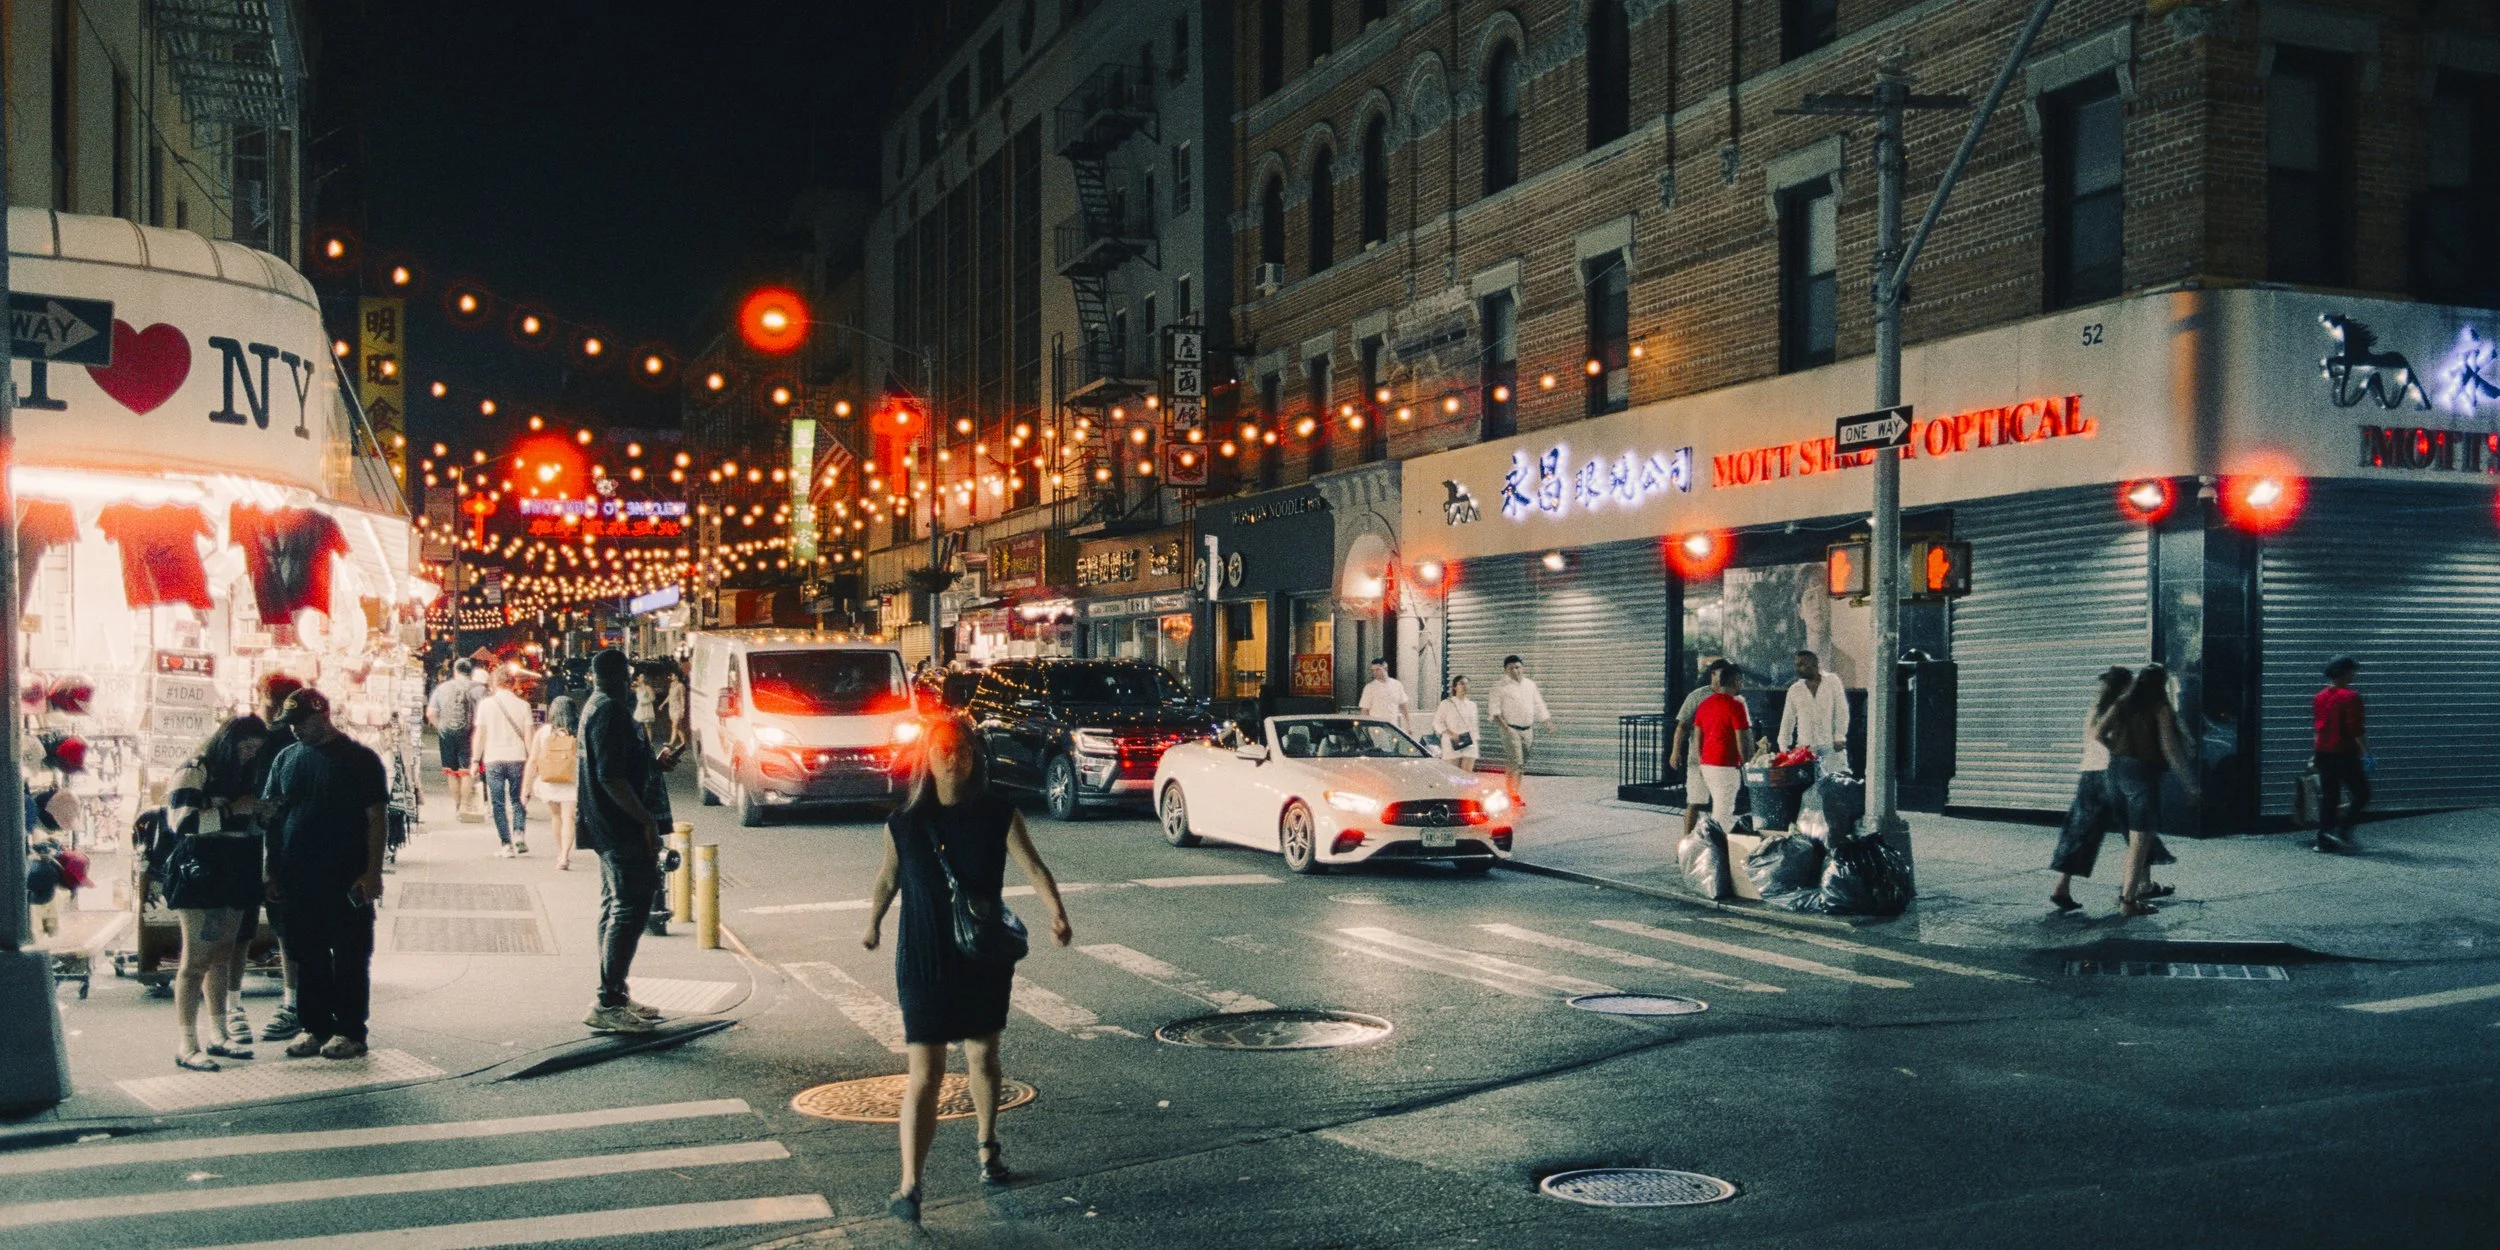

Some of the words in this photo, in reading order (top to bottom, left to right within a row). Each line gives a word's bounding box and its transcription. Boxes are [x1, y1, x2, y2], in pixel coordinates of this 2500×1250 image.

[2081, 322, 2104, 346] 52
[208, 335, 315, 440] NY
[1712, 442, 1796, 487] MOTT
[1923, 394, 2088, 457] OPTICAL
[1845, 424, 1868, 442] ONE
[1878, 419, 1900, 437] WAY
[2358, 424, 2481, 473] MOTT
[1269, 497, 1305, 518] NOODLE
[183, 656, 208, 669] NY
